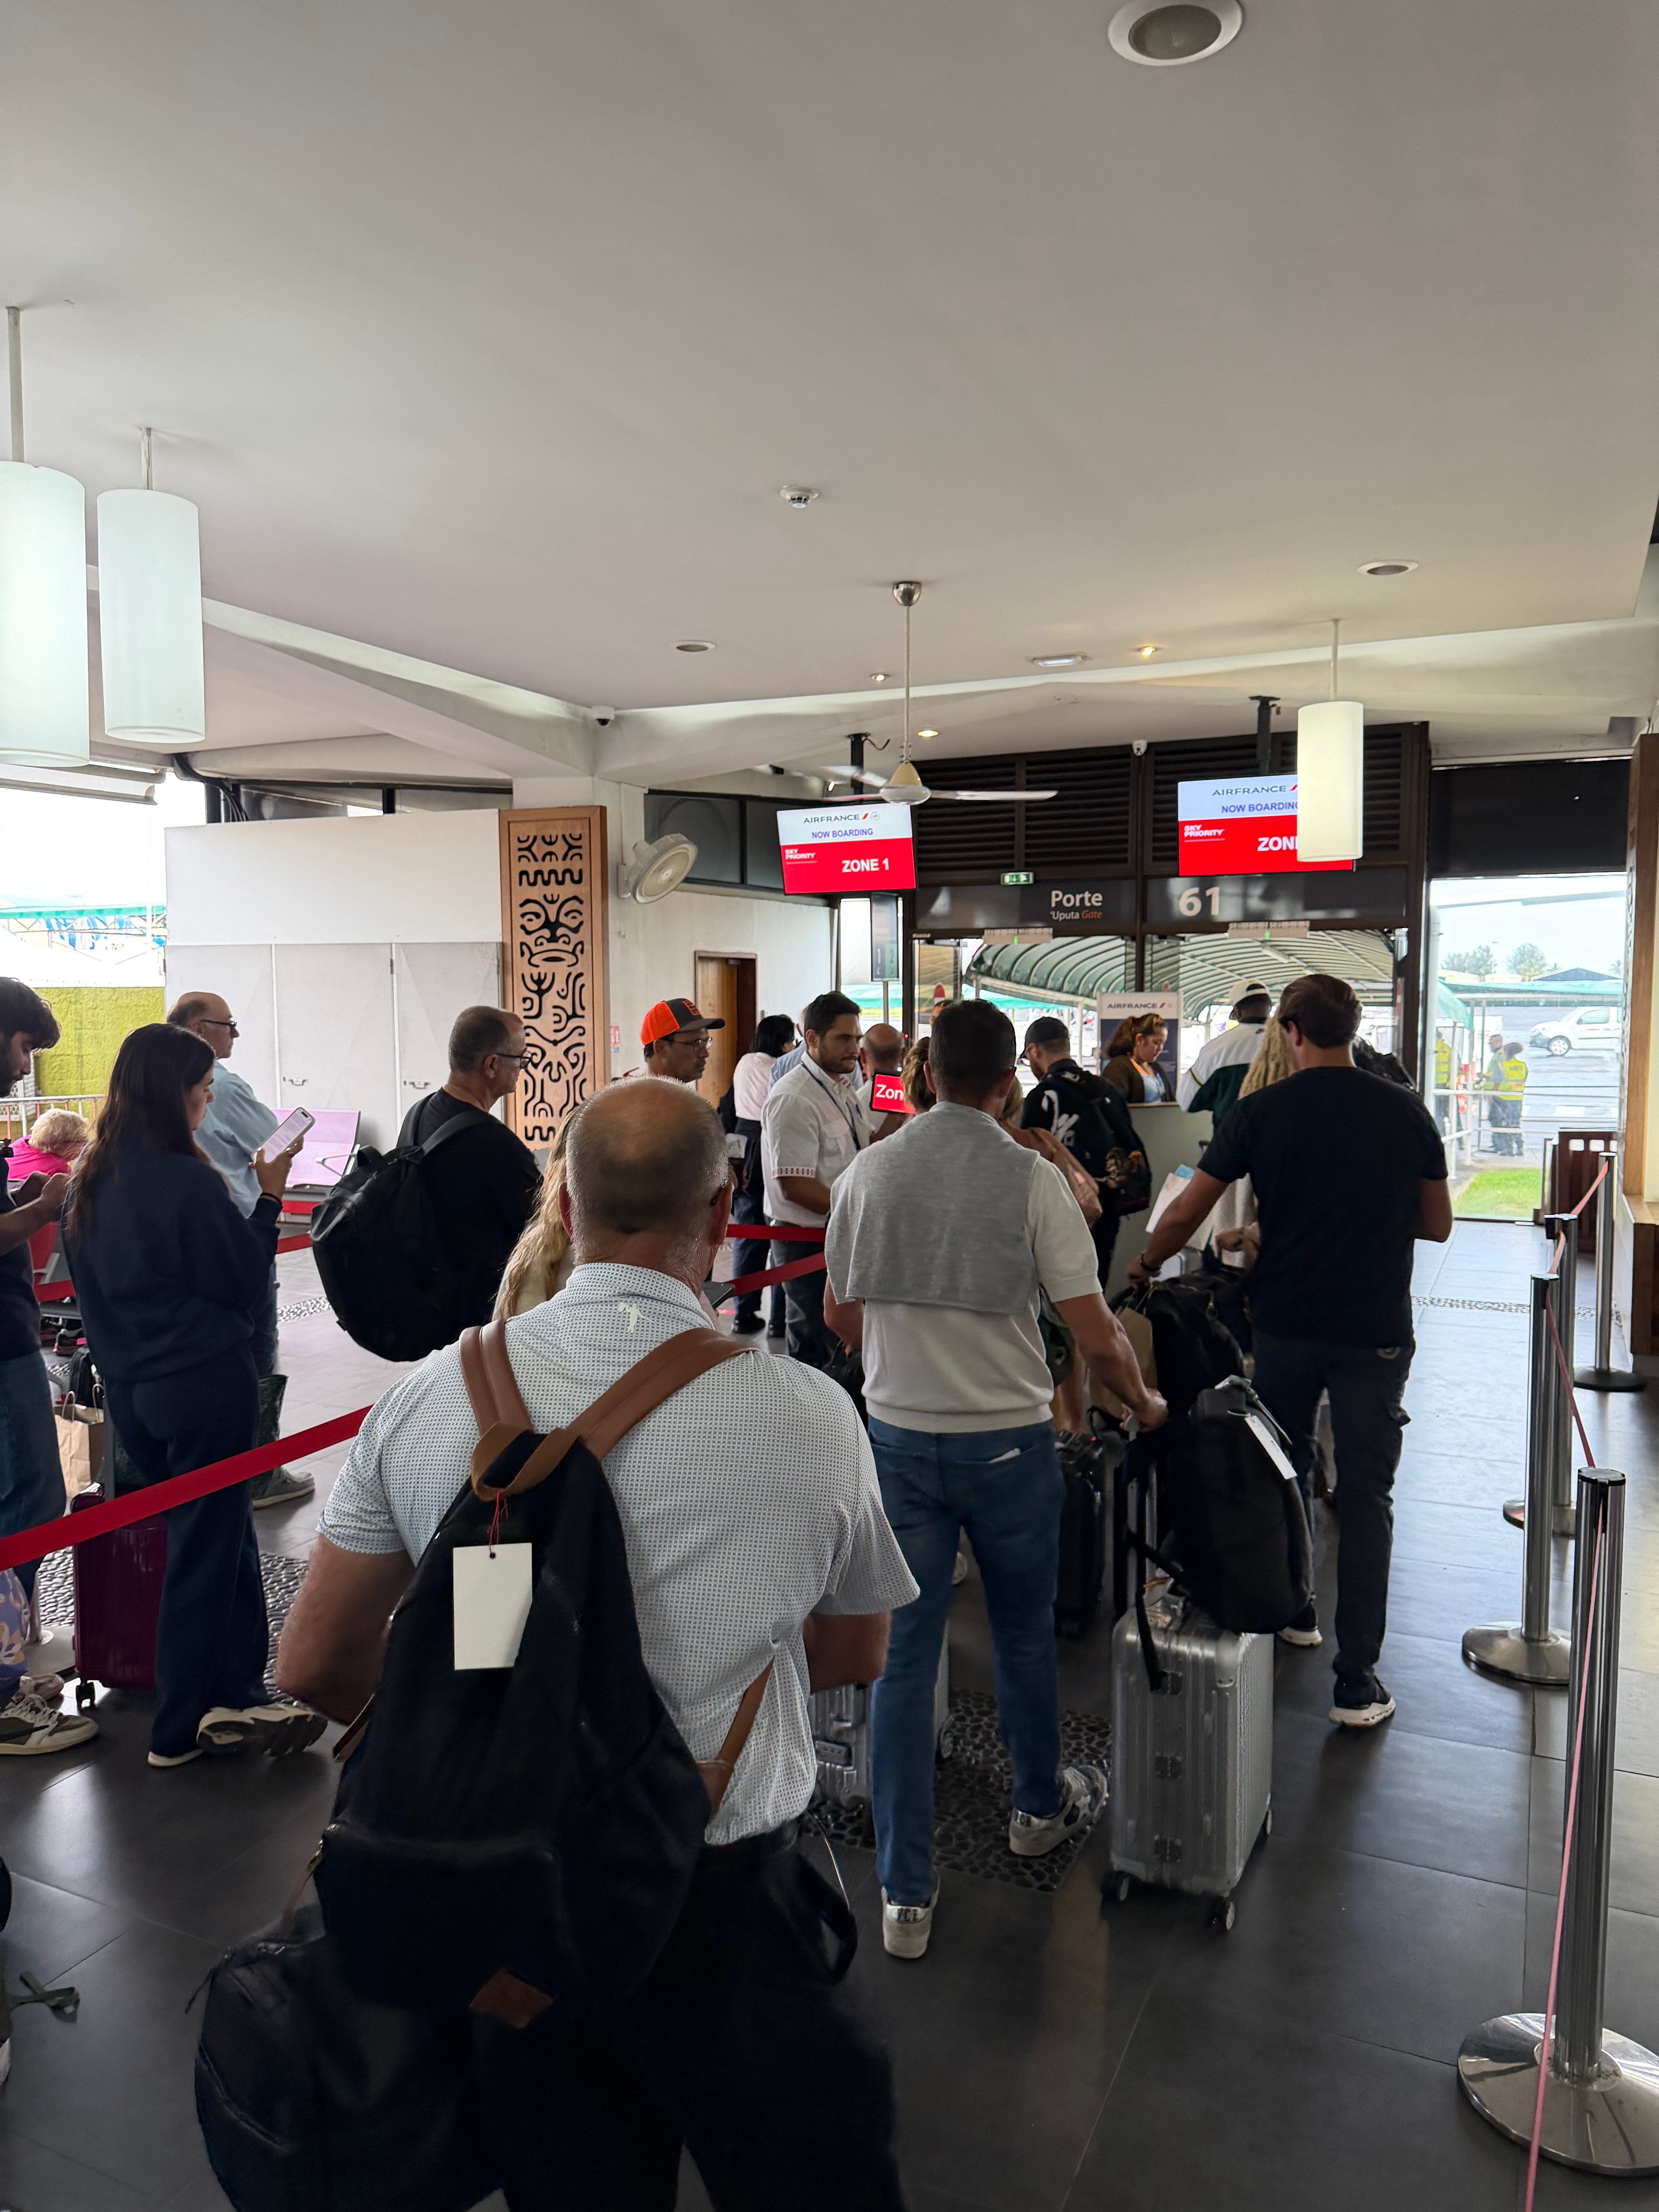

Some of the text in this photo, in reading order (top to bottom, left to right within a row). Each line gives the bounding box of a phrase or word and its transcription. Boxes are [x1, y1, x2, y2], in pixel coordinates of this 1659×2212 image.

[1212, 785, 1286, 796] AIRFRANCE
[1221, 804, 1246, 813] NOW
[804, 814, 860, 823] AIRFRANCE
[832, 828, 873, 838] BOARDING
[1184, 829, 1225, 838] PRIORITY
[1257, 836, 1298, 852] ZON
[842, 858, 890, 873] ZONE 1
[1051, 890, 1103, 907] Porte
[1179, 886, 1220, 917] 61
[1081, 910, 1103, 919] Gate
[876, 1084, 903, 1100] Zon
